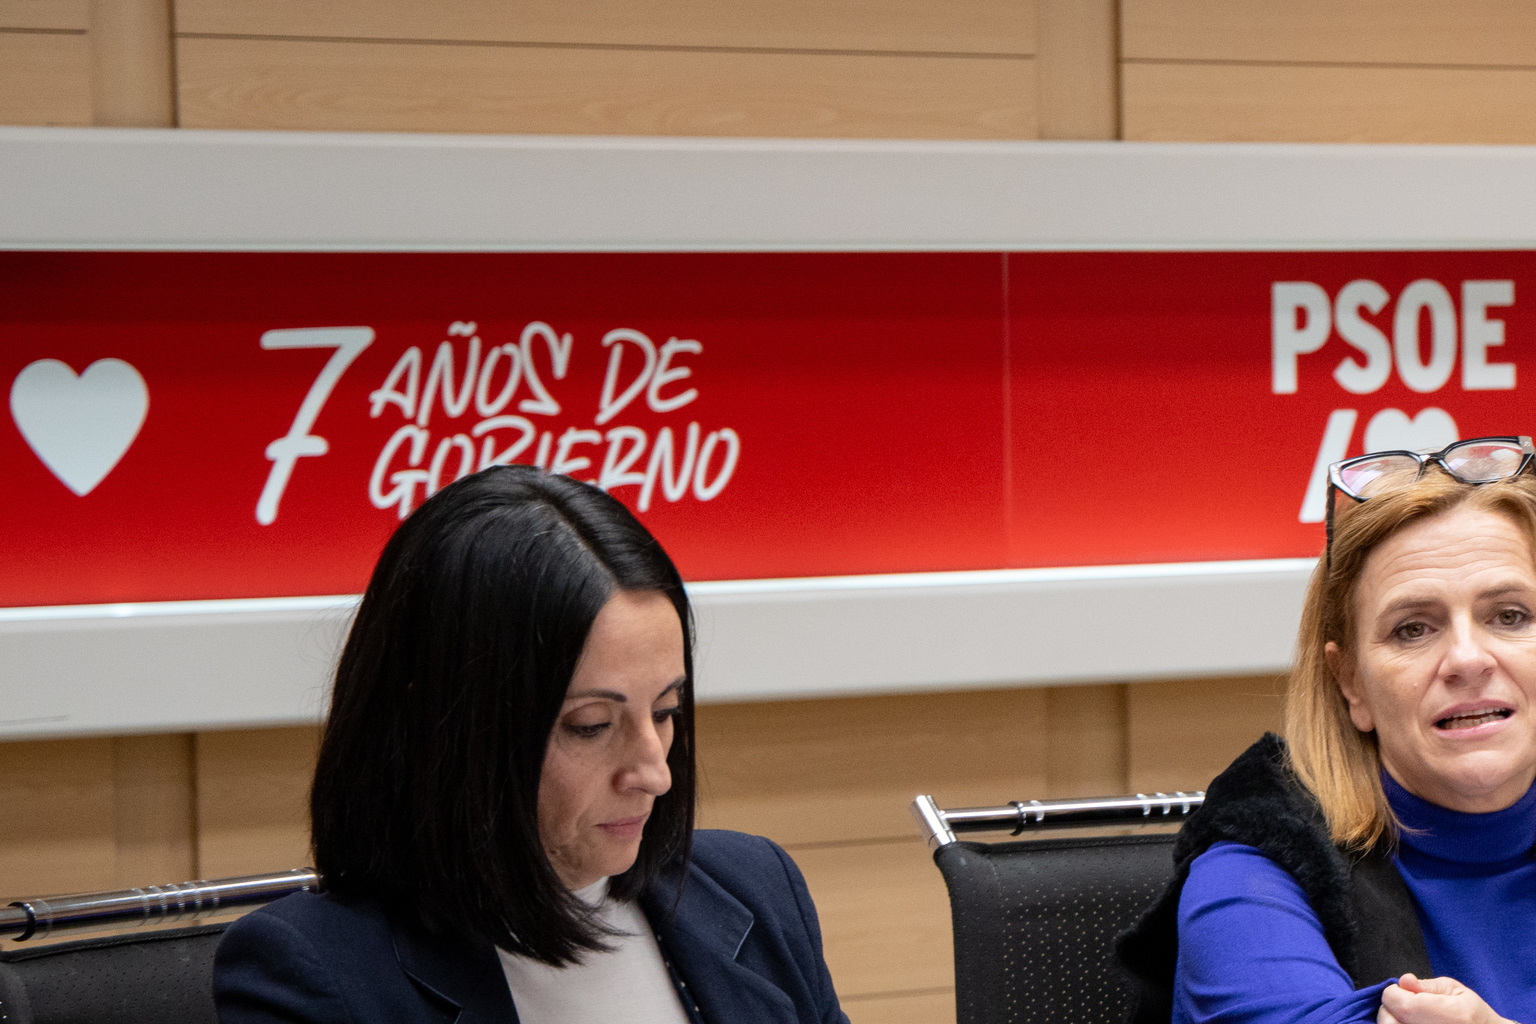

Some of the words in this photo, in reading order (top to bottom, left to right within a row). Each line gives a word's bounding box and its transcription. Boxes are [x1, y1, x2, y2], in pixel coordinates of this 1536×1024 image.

[1269, 278, 1517, 395] PSOE
[255, 324, 376, 526] 7
[368, 320, 575, 428] AÑOS
[594, 327, 704, 426] DE
